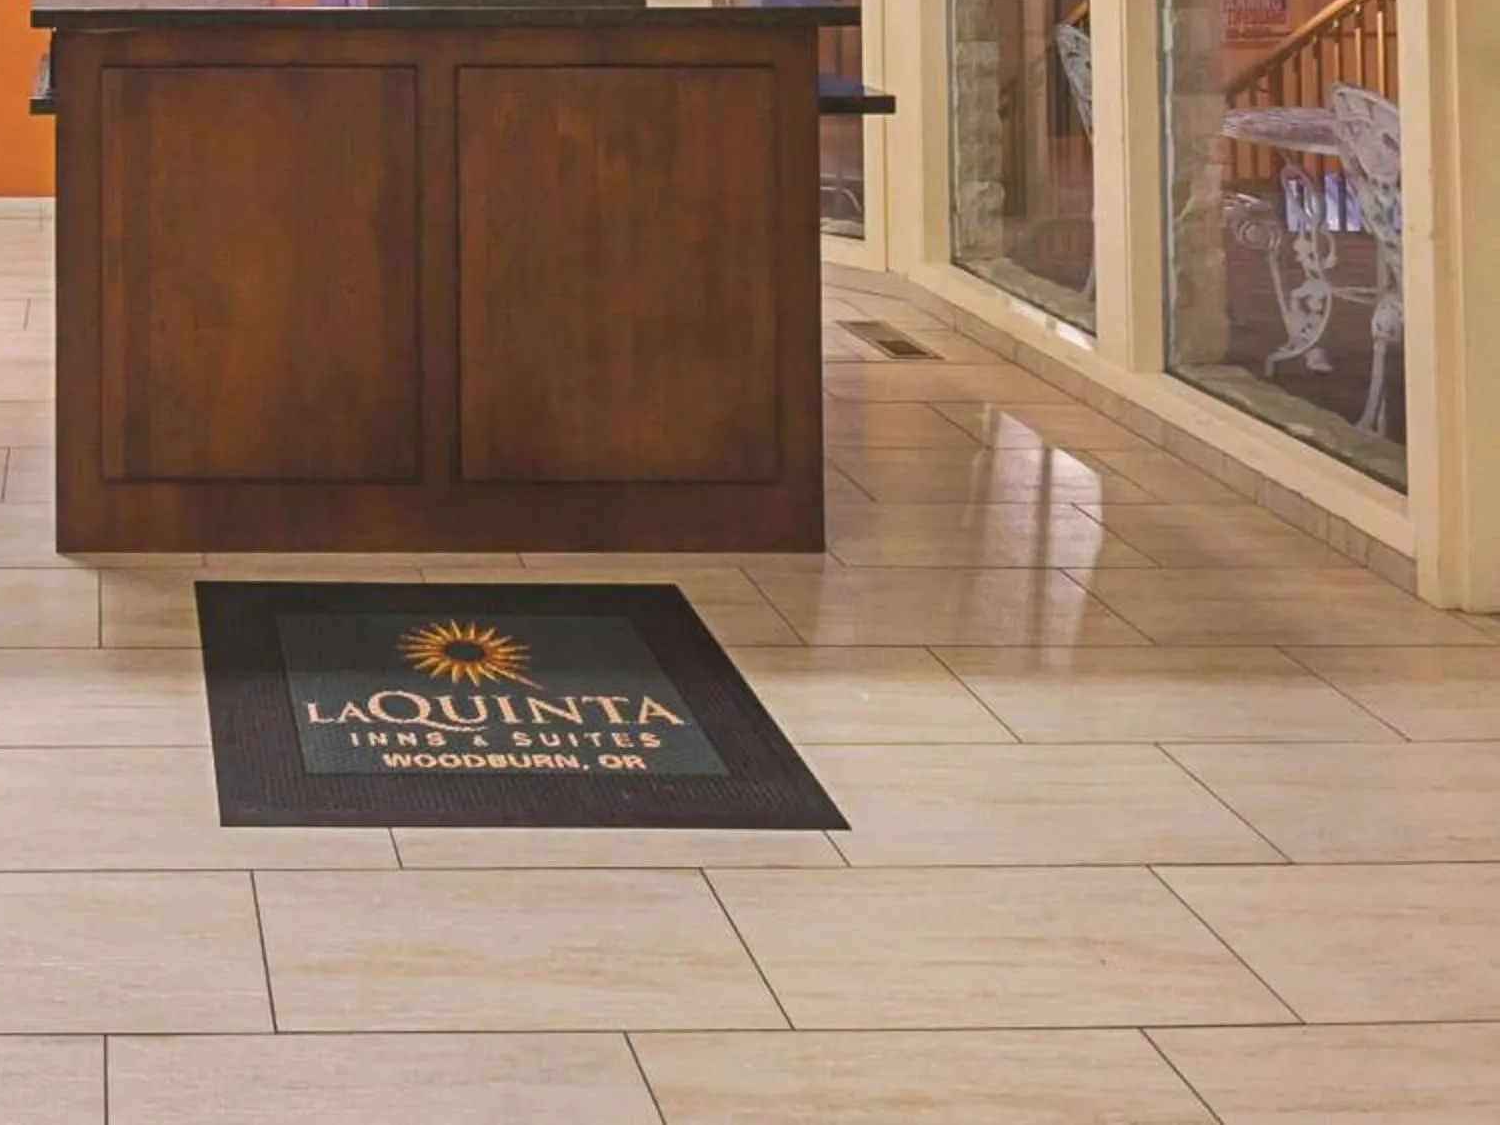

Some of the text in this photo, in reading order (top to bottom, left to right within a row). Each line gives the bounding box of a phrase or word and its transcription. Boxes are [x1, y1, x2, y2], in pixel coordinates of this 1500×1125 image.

[350, 732, 662, 747] INNS & SUITES
[599, 754, 647, 770] OR
